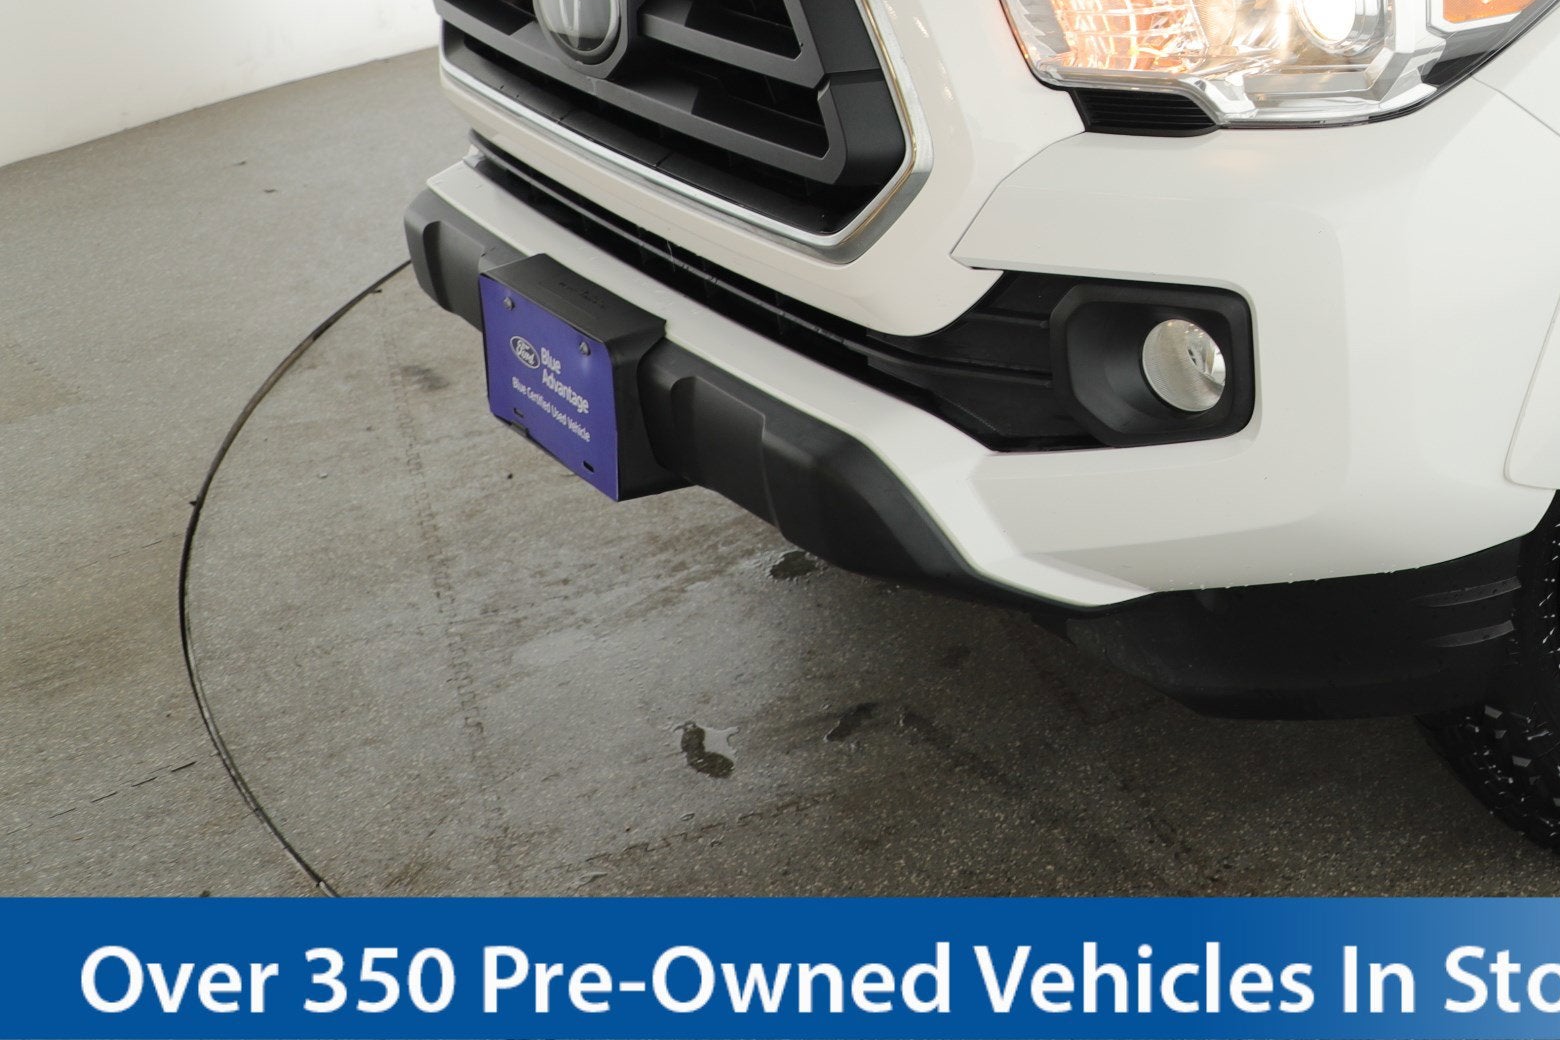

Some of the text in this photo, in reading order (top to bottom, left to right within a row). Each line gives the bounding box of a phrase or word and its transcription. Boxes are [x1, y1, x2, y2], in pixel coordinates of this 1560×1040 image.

[541, 347, 561, 374] Blue
[512, 376, 590, 442] Blue Certified Used Vehicle
[542, 368, 589, 414] Advantage
